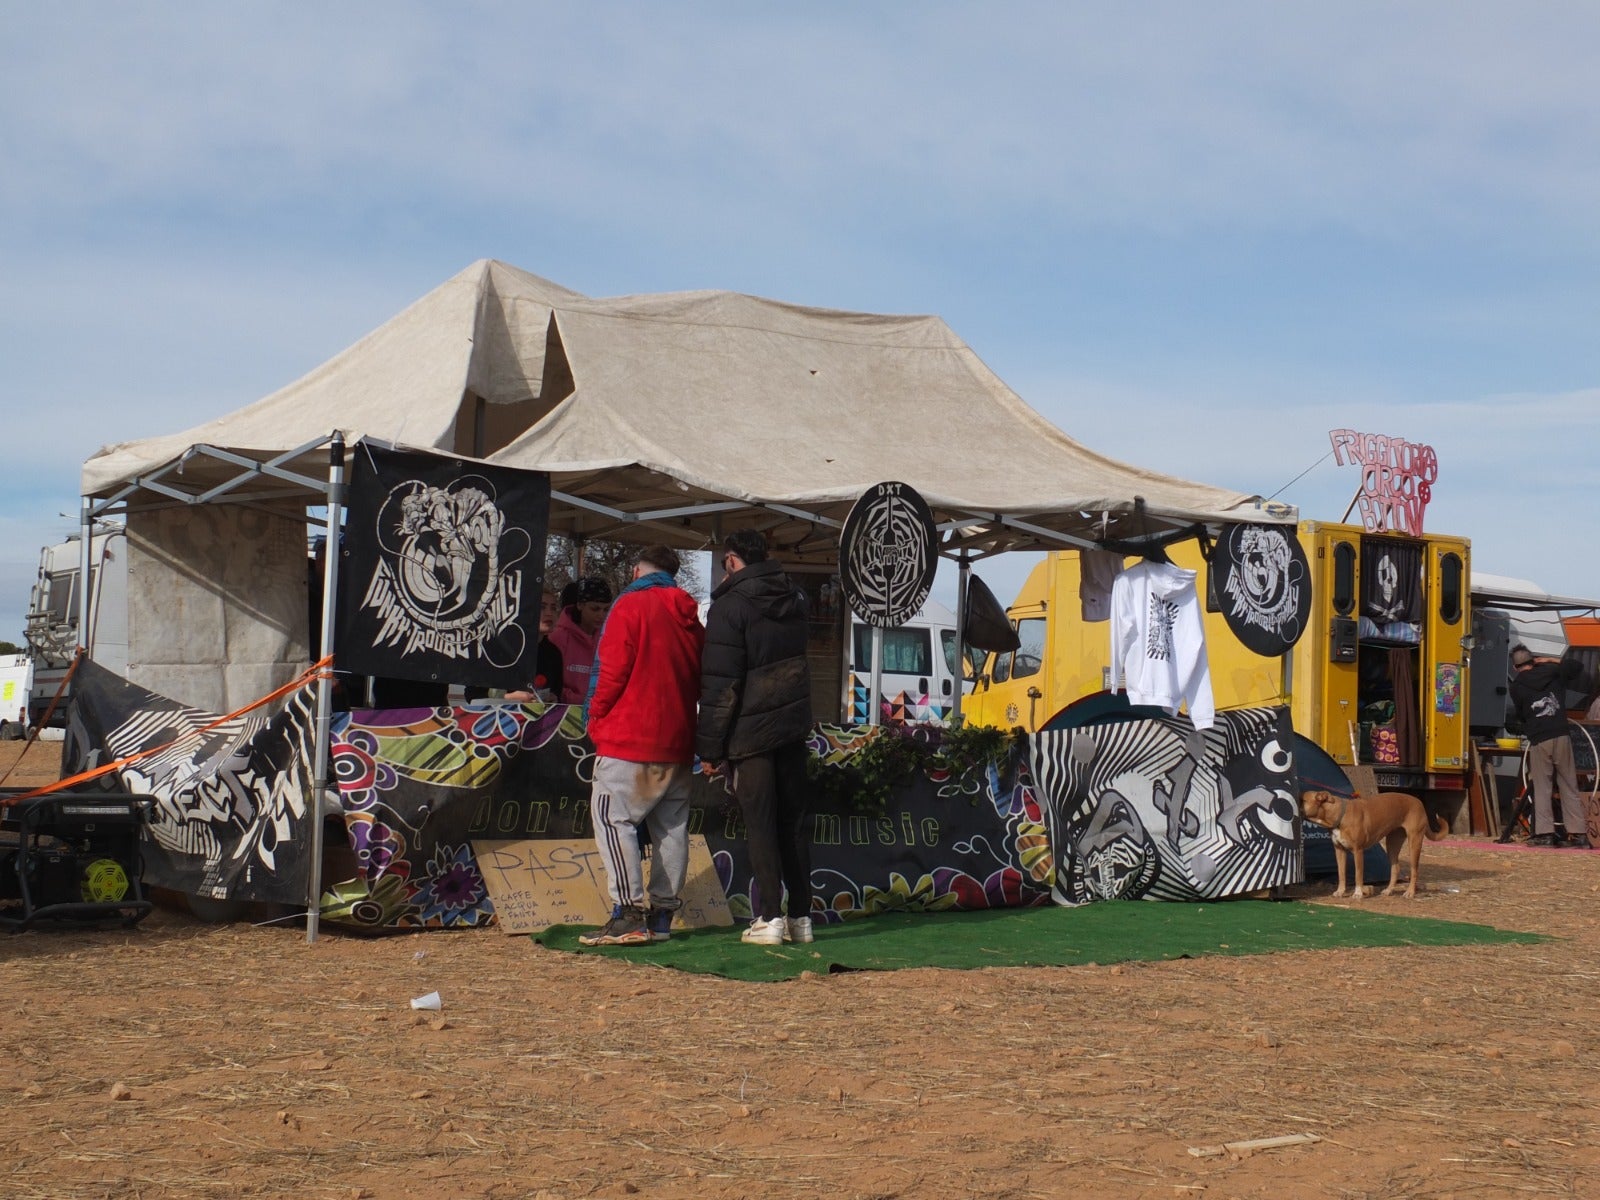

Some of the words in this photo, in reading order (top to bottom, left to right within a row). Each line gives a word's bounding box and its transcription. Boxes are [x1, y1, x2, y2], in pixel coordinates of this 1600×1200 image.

[878, 483, 902, 496] DXT
[1362, 463, 1415, 500] CIRCO
[849, 587, 929, 628] DIXCONNECTION
[814, 812, 940, 846] music
[492, 847, 606, 889] PAST
